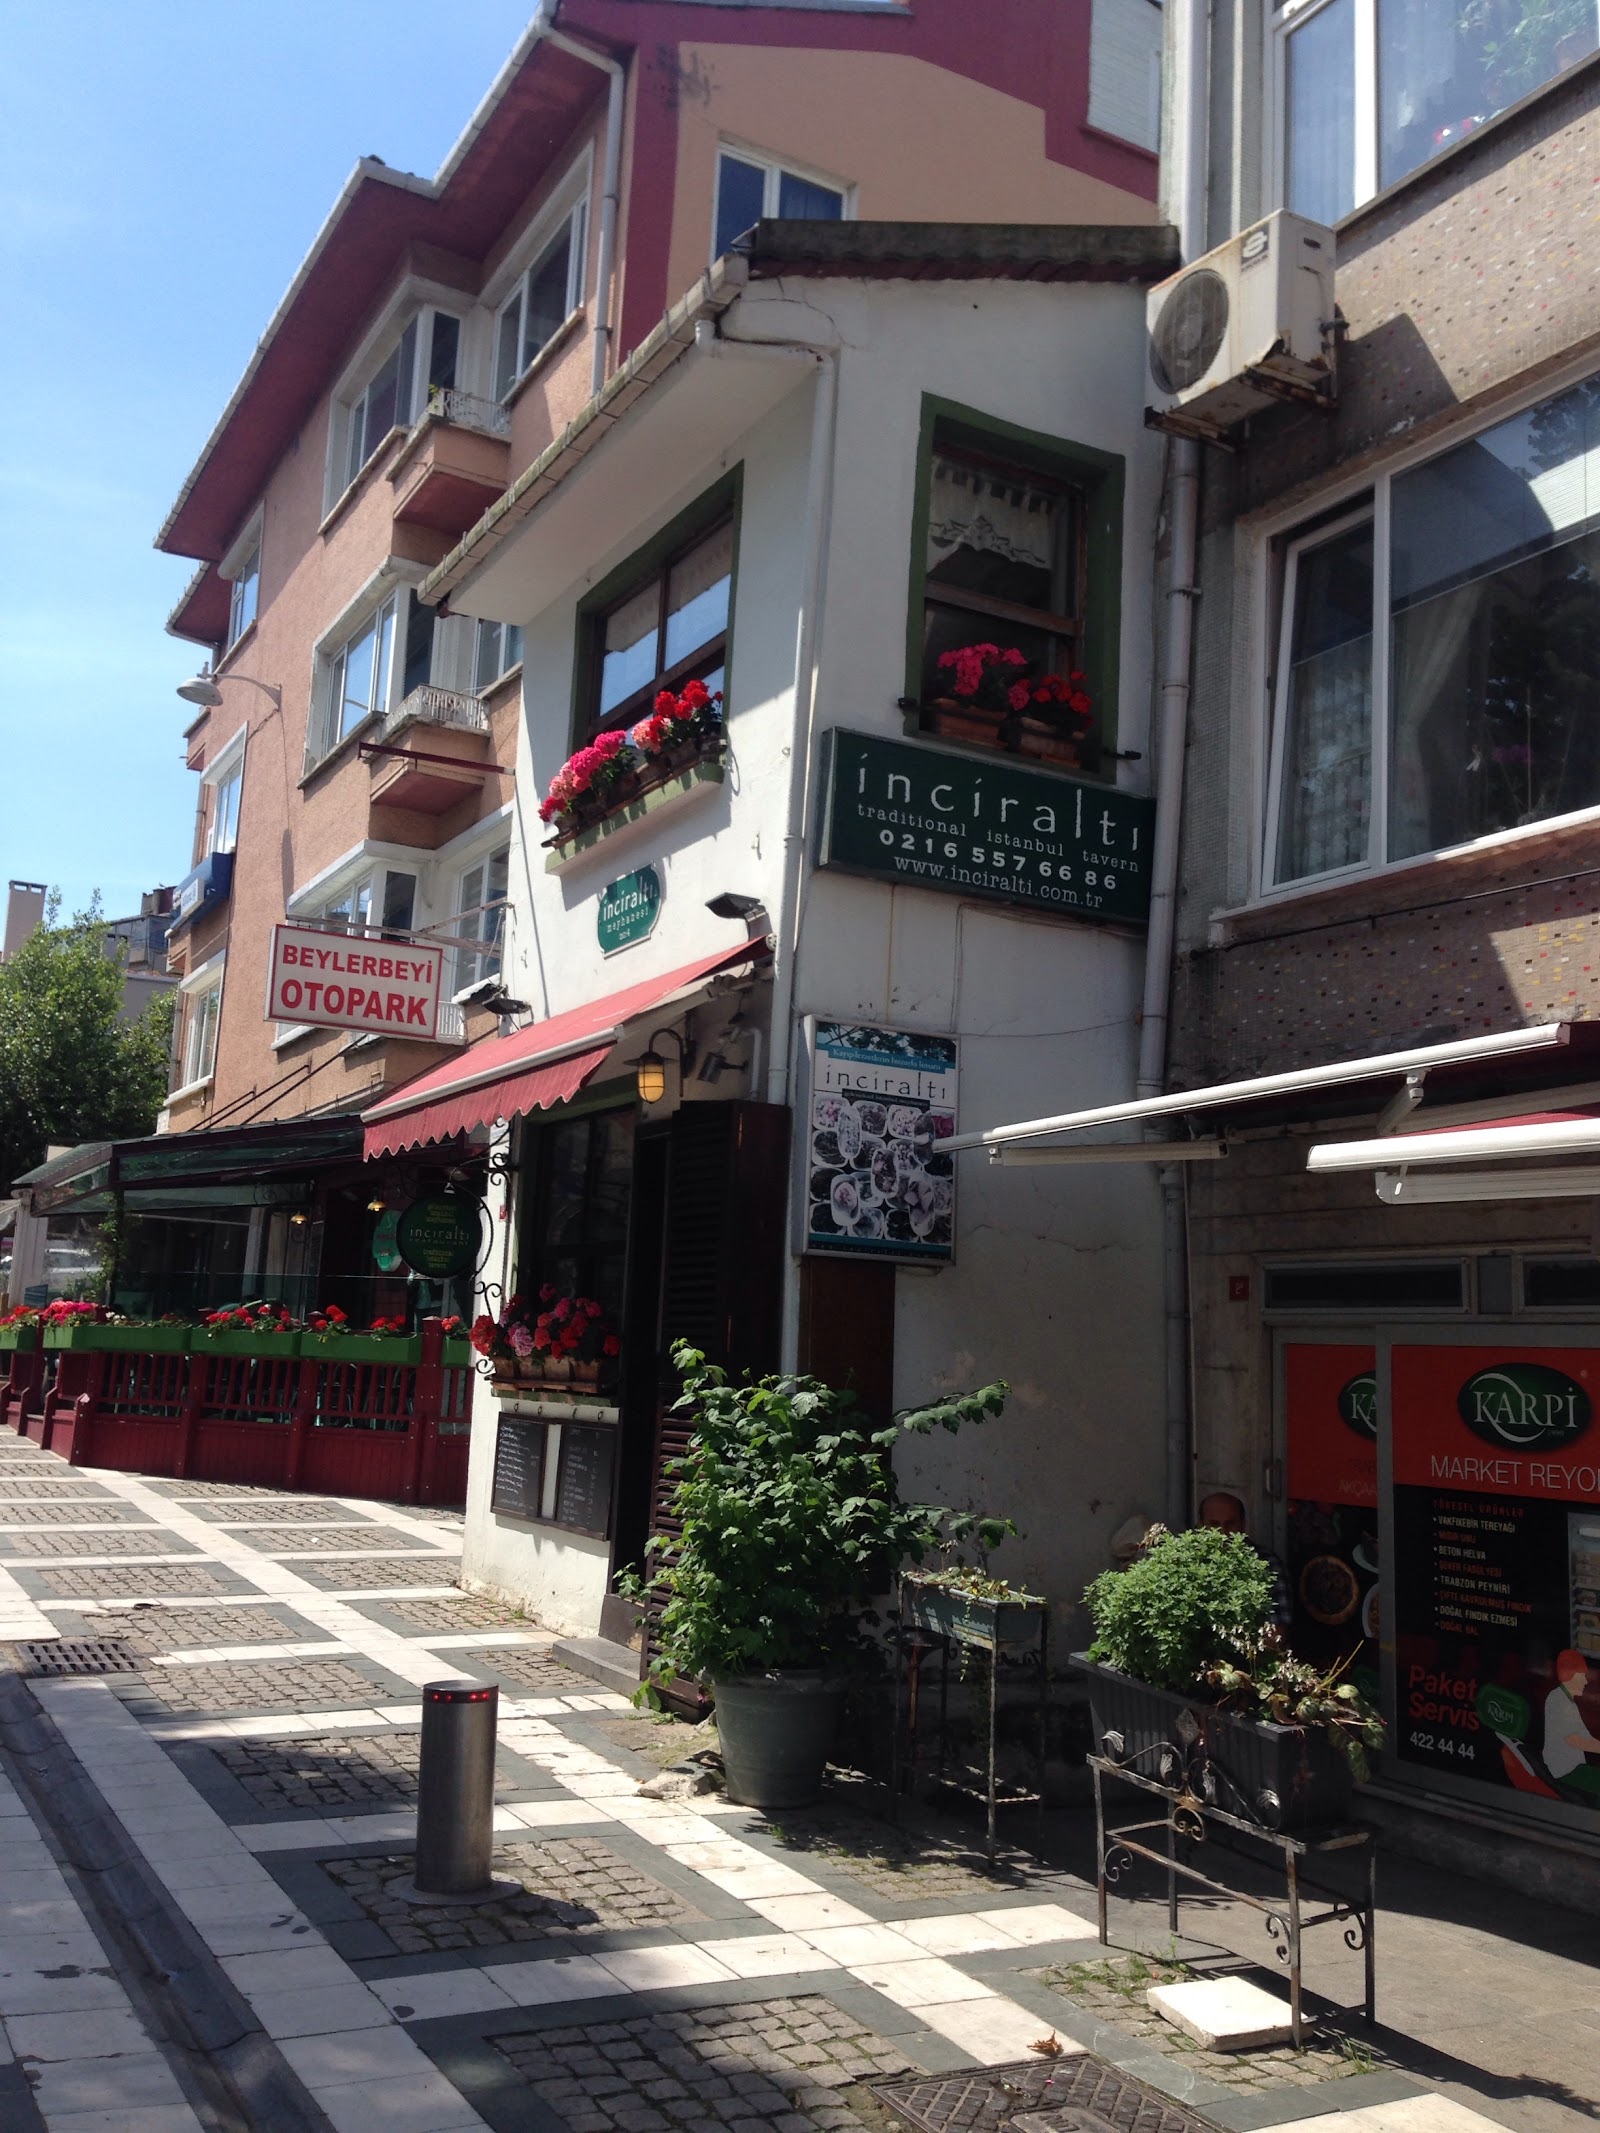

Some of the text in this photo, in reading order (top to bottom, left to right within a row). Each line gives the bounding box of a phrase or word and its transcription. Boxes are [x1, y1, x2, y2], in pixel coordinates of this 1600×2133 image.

[858, 803, 1139, 873] traditional istanbul tavern
[879, 829, 1116, 890] 0216 557 66 86
[894, 855, 1103, 909] www.inciralti.com.tr
[282, 944, 433, 983] BEYLERBEYİ
[280, 979, 429, 1026] OTOPARK
[1471, 1385, 1579, 1430] KARPİ
[1431, 1455, 1600, 1493] MARKET REYO
[1438, 1545, 1486, 1560] BETON HELVA
[1440, 1575, 1511, 1594] TRABZON PEYNİRİ
[1440, 1605, 1518, 1627] DOĞAL FINDIK EZMESİ
[1408, 1664, 1478, 1702] Paket
[1408, 1691, 1480, 1732] Servis
[1409, 1731, 1476, 1760] 422 44 44
